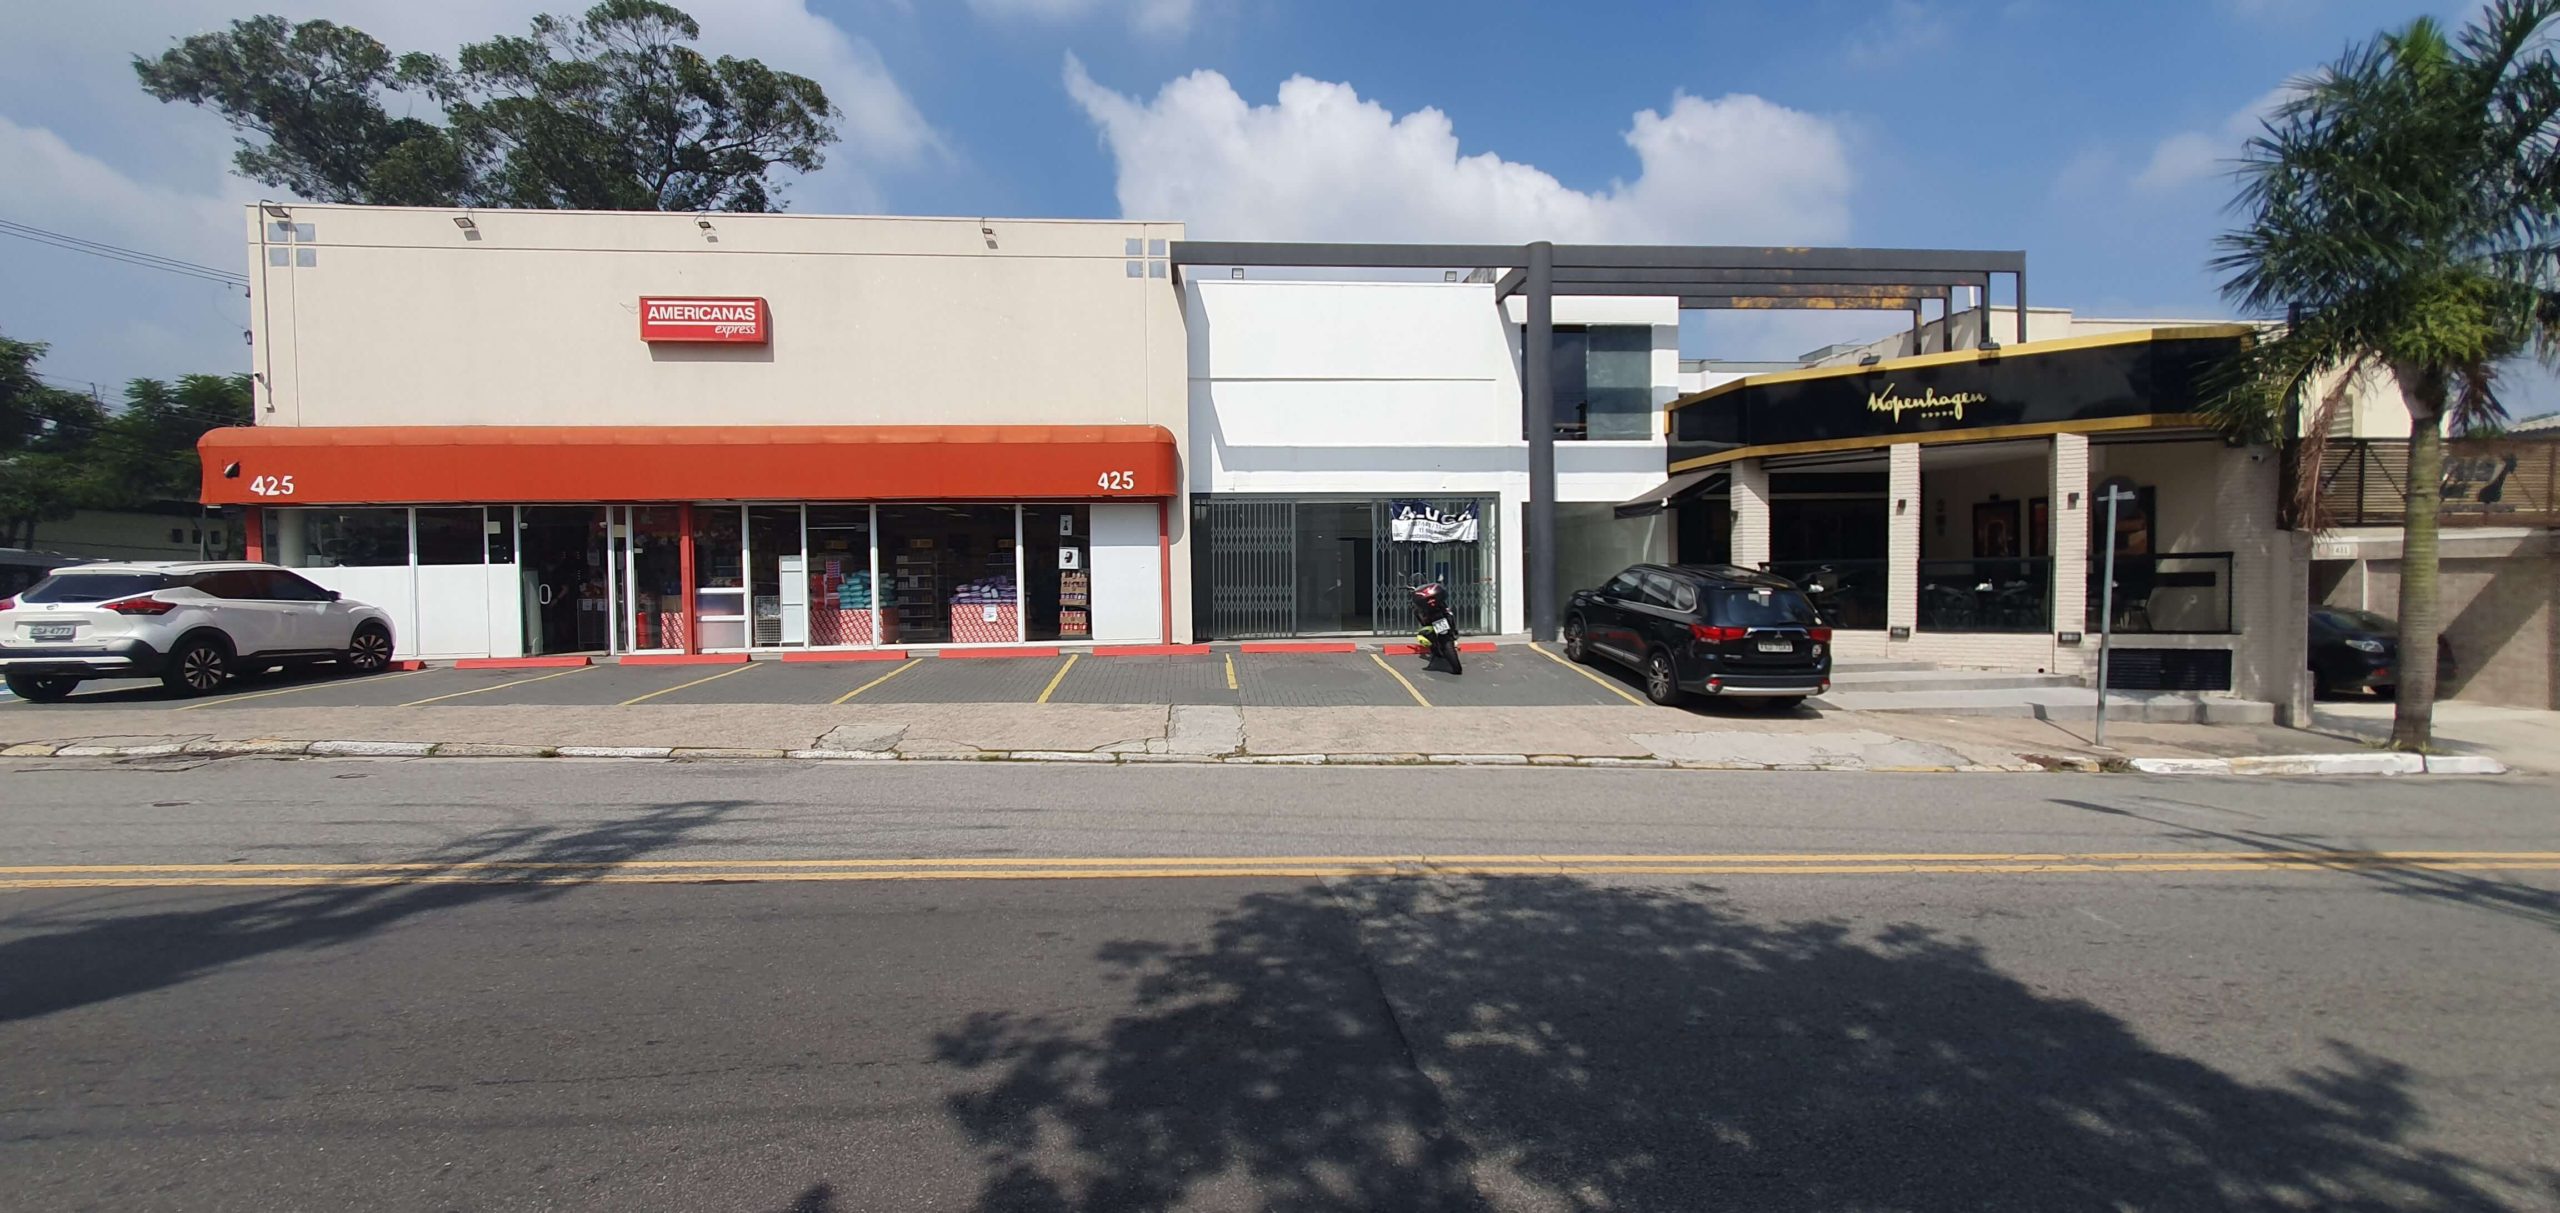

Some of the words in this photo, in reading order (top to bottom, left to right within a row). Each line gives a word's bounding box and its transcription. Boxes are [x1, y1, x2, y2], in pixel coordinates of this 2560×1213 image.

[647, 306, 756, 321] AMERICANAS
[714, 324, 756, 338] express
[1867, 382, 1986, 424] Kopenhagen
[250, 475, 294, 496] 425
[1097, 471, 1134, 490] 425
